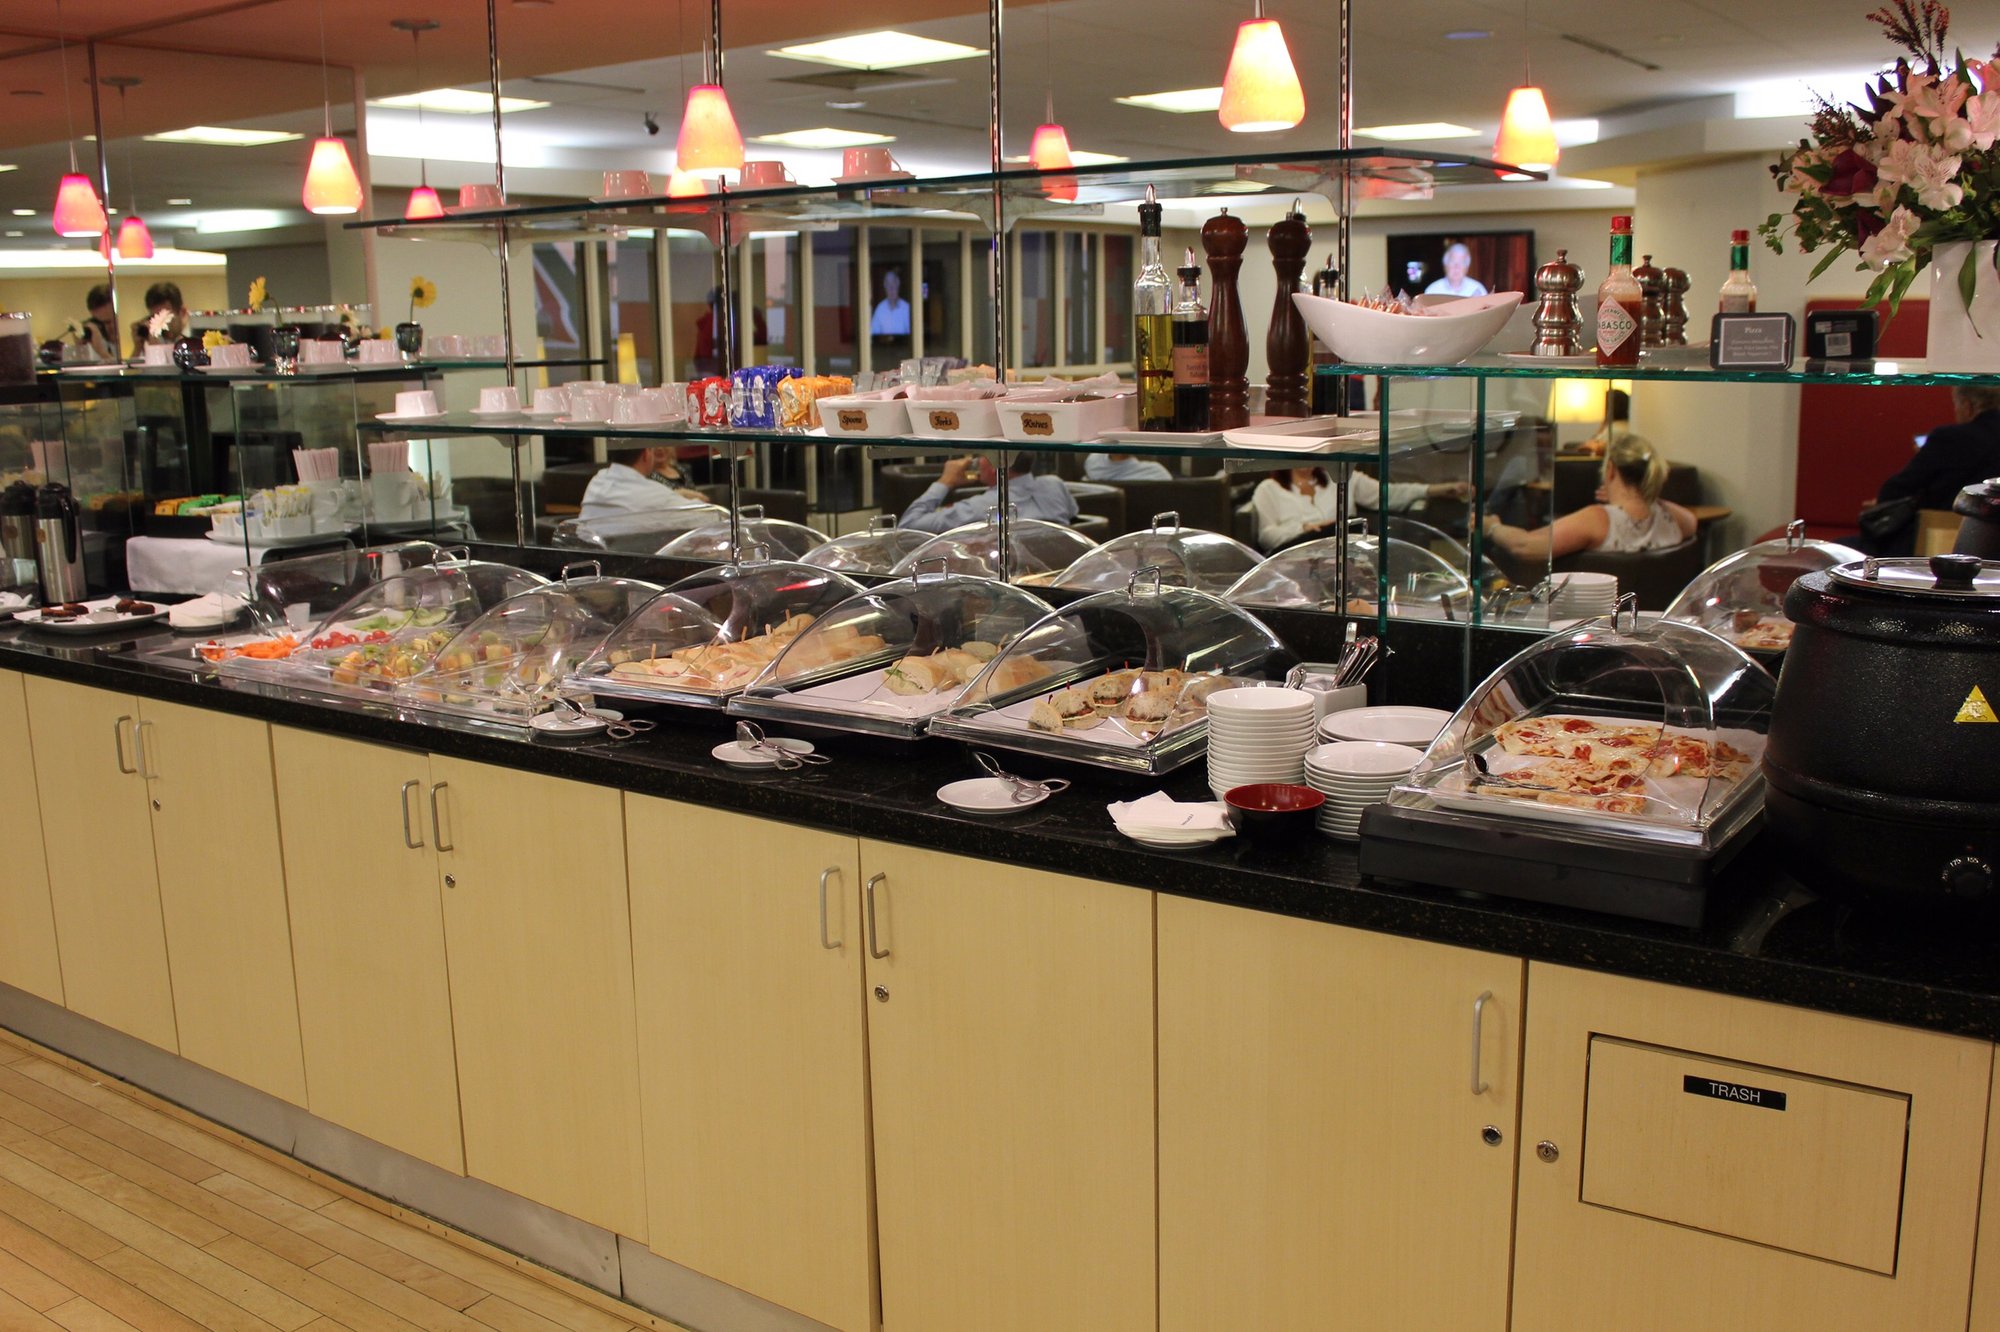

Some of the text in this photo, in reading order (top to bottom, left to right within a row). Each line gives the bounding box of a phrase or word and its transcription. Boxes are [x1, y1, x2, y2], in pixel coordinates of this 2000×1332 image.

[1597, 320, 1632, 330] ABASCO
[842, 415, 862, 425] Spoons
[935, 416, 952, 425] Forks
[1023, 419, 1048, 429] Knives
[1709, 1082, 1760, 1103] TRASH
